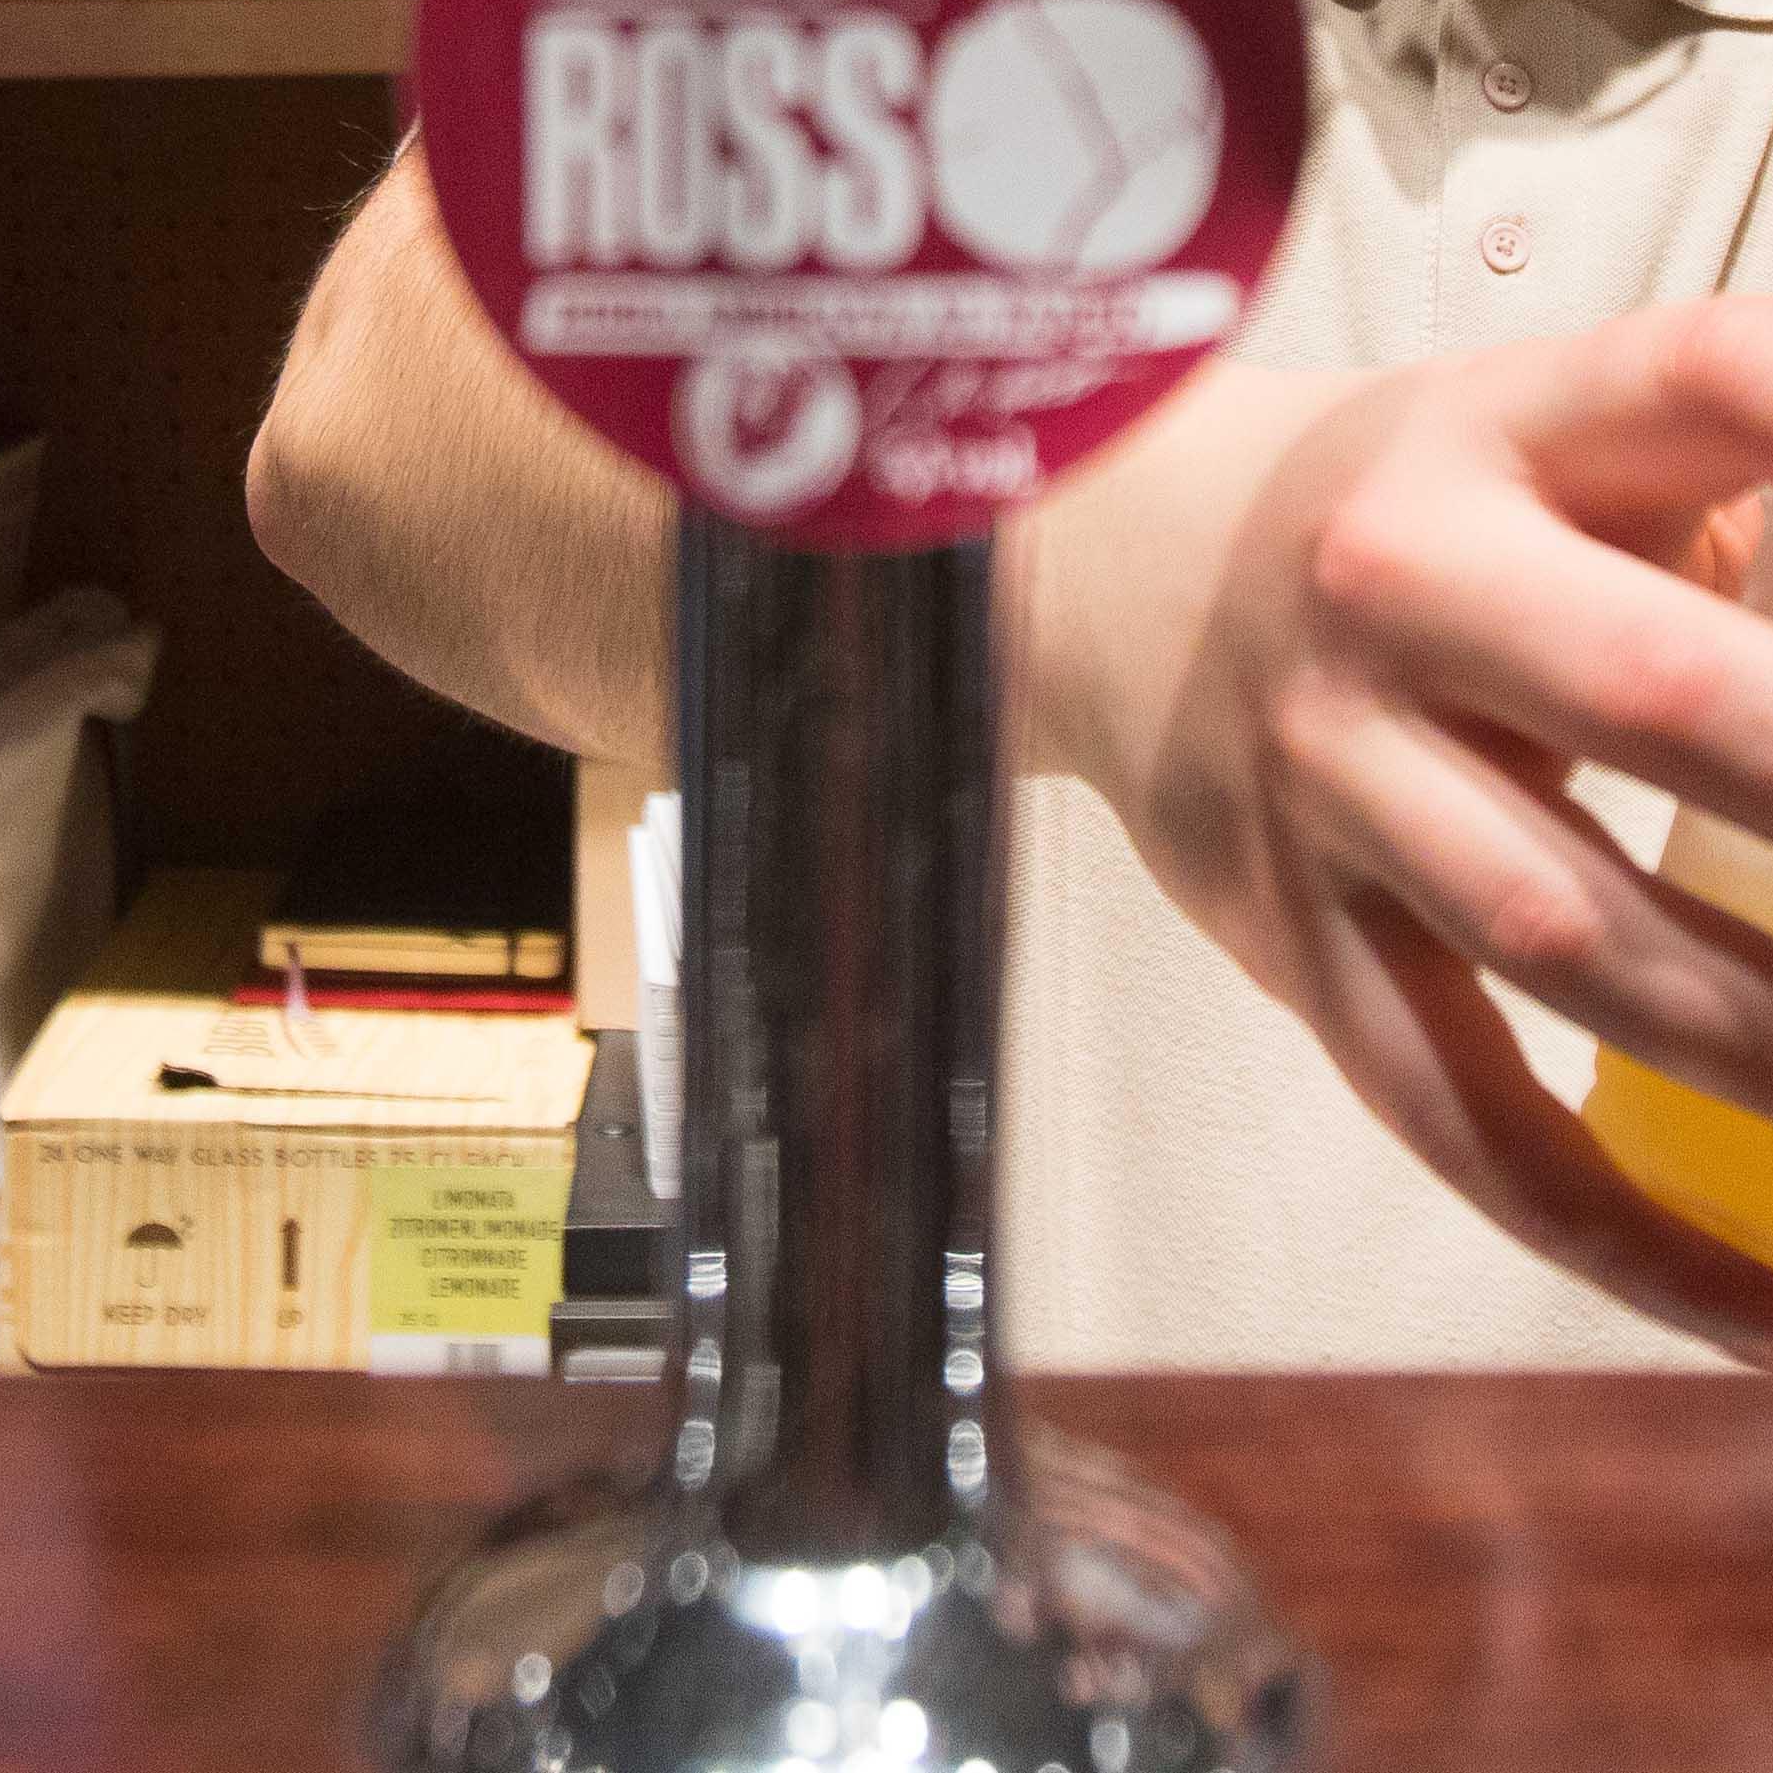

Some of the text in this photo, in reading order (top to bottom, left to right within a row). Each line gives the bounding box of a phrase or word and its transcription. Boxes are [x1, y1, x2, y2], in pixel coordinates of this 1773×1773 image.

[74, 1145, 122, 1165] ONE
[133, 1145, 178, 1166] WAY
[191, 1147, 265, 1168] GLASS
[274, 1148, 378, 1170] BOTTLES
[430, 1277, 522, 1299] LEMONADE
[103, 1304, 207, 1328] KEEP DRY
